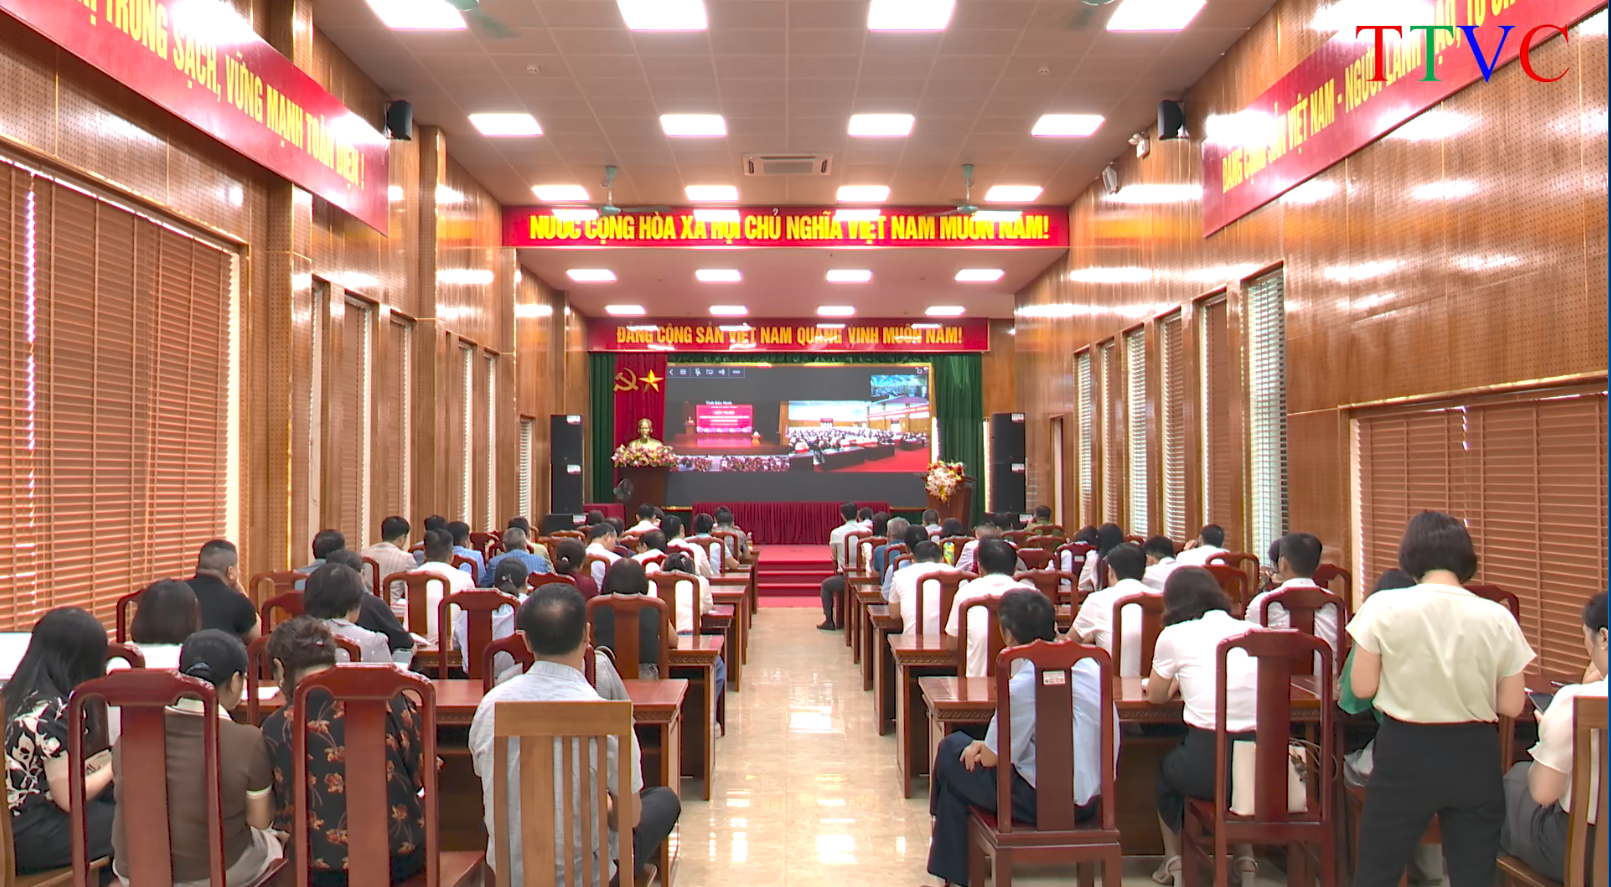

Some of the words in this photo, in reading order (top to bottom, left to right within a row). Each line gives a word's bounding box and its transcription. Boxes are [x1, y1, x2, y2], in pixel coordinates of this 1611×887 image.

[225, 50, 263, 124] VỮNG
[266, 83, 304, 150] MẠNH
[305, 112, 335, 171] TOÀN
[1287, 92, 1308, 155] VIỆT
[1309, 77, 1335, 137] NAM
[1345, 44, 1383, 114] NGƯỜ
[1425, 0, 1461, 65] ẠO,
[639, 211, 677, 240] HÒA
[744, 208, 782, 240] CHỦ
[786, 210, 843, 240] NGHĨA
[891, 215, 936, 240] NAM
[616, 321, 653, 344] ĐẢNG
[656, 323, 693, 346] CỘNG
[695, 321, 724, 344] SẢN
[760, 326, 792, 344] NAM
[796, 326, 843, 346] QUANG
[847, 326, 879, 344] VINH
[882, 323, 923, 344] MUÔN
